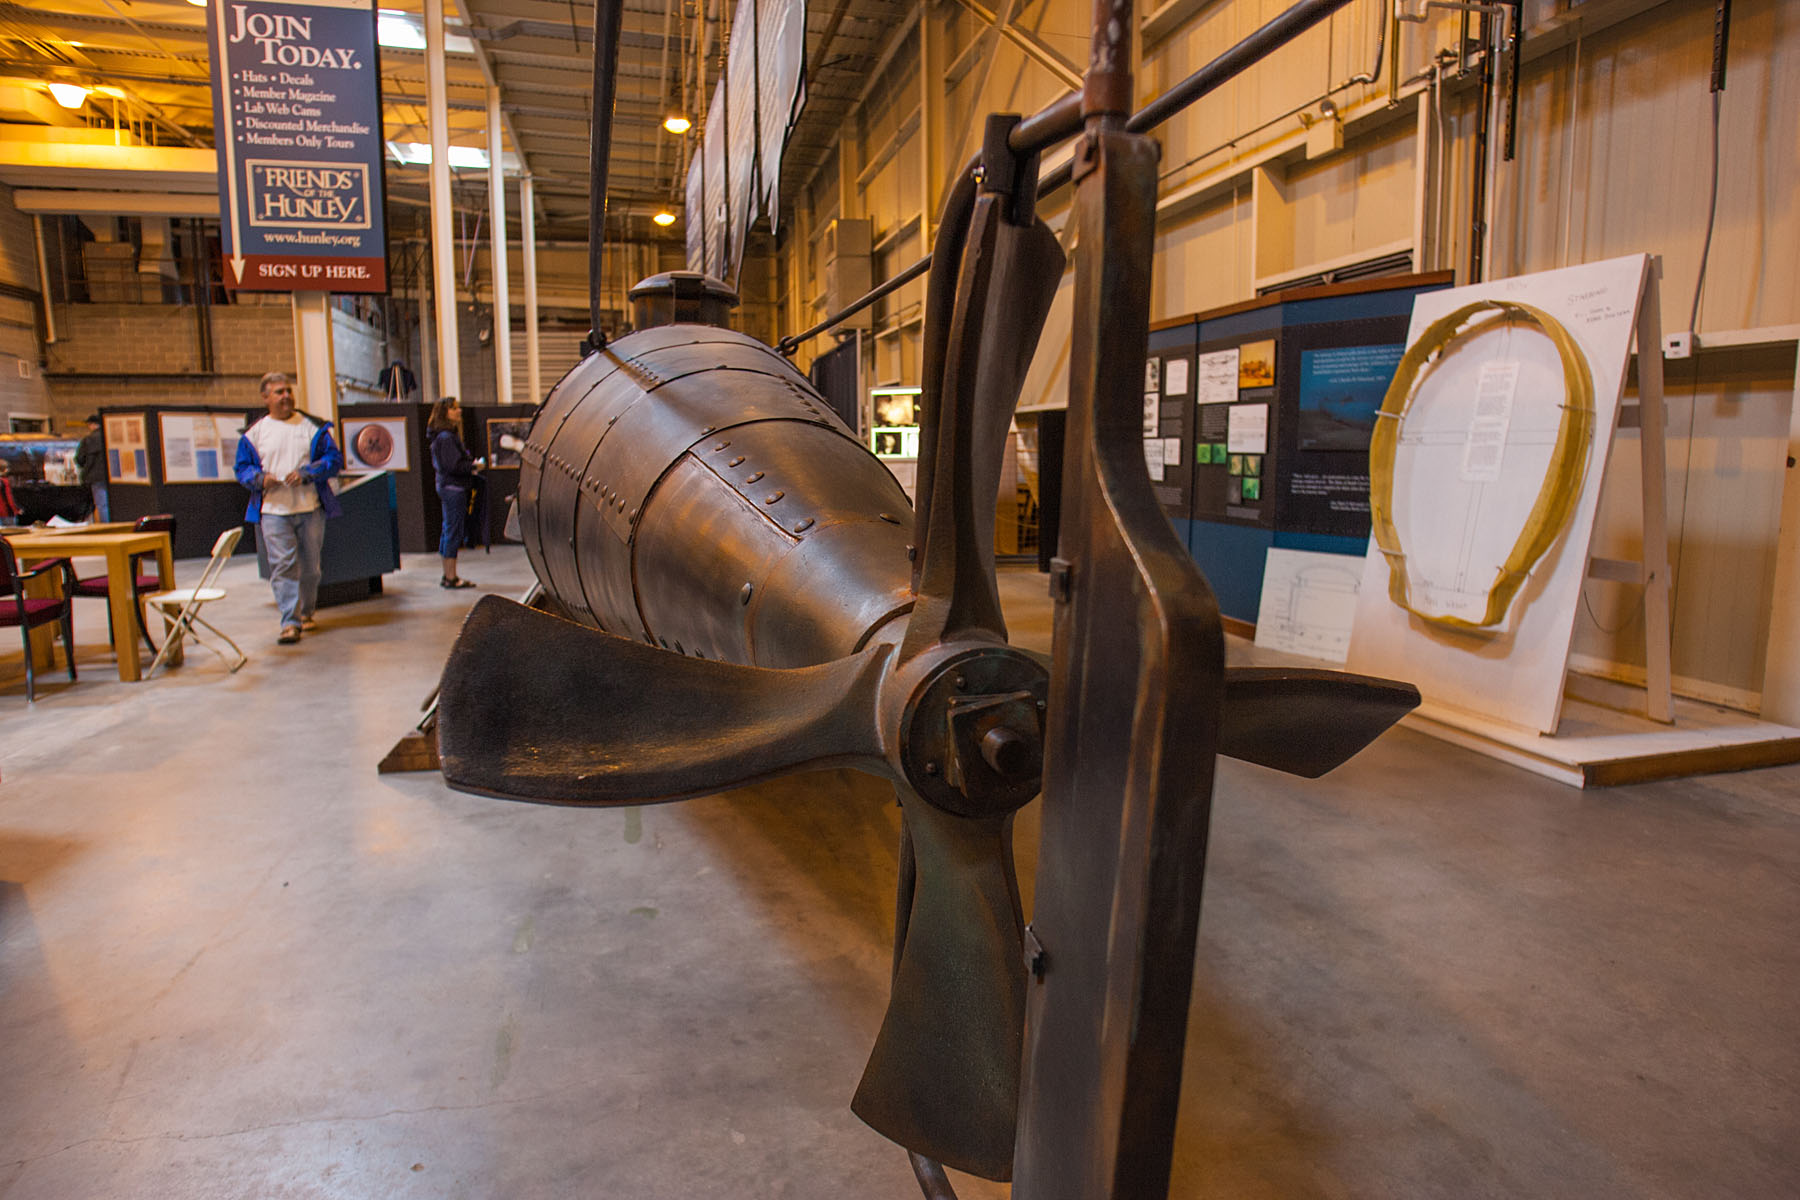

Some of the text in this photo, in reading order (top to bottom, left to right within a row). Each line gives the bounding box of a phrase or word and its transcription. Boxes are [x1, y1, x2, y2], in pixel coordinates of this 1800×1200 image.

[230, 4, 312, 43] JOIN
[242, 70, 314, 86] Hats Decals
[243, 86, 336, 103] Member Magazine
[244, 101, 321, 117] Lab Web Cams
[245, 117, 370, 134] Discounted Merchandise
[246, 132, 354, 149] Members Only Tours
[264, 167, 353, 190] FRIENDS
[303, 188, 335, 198] OF THE
[264, 193, 358, 223] HUNLEY
[263, 230, 361, 248] www.hunley.org
[258, 263, 371, 279] SIGN UP HERE.
